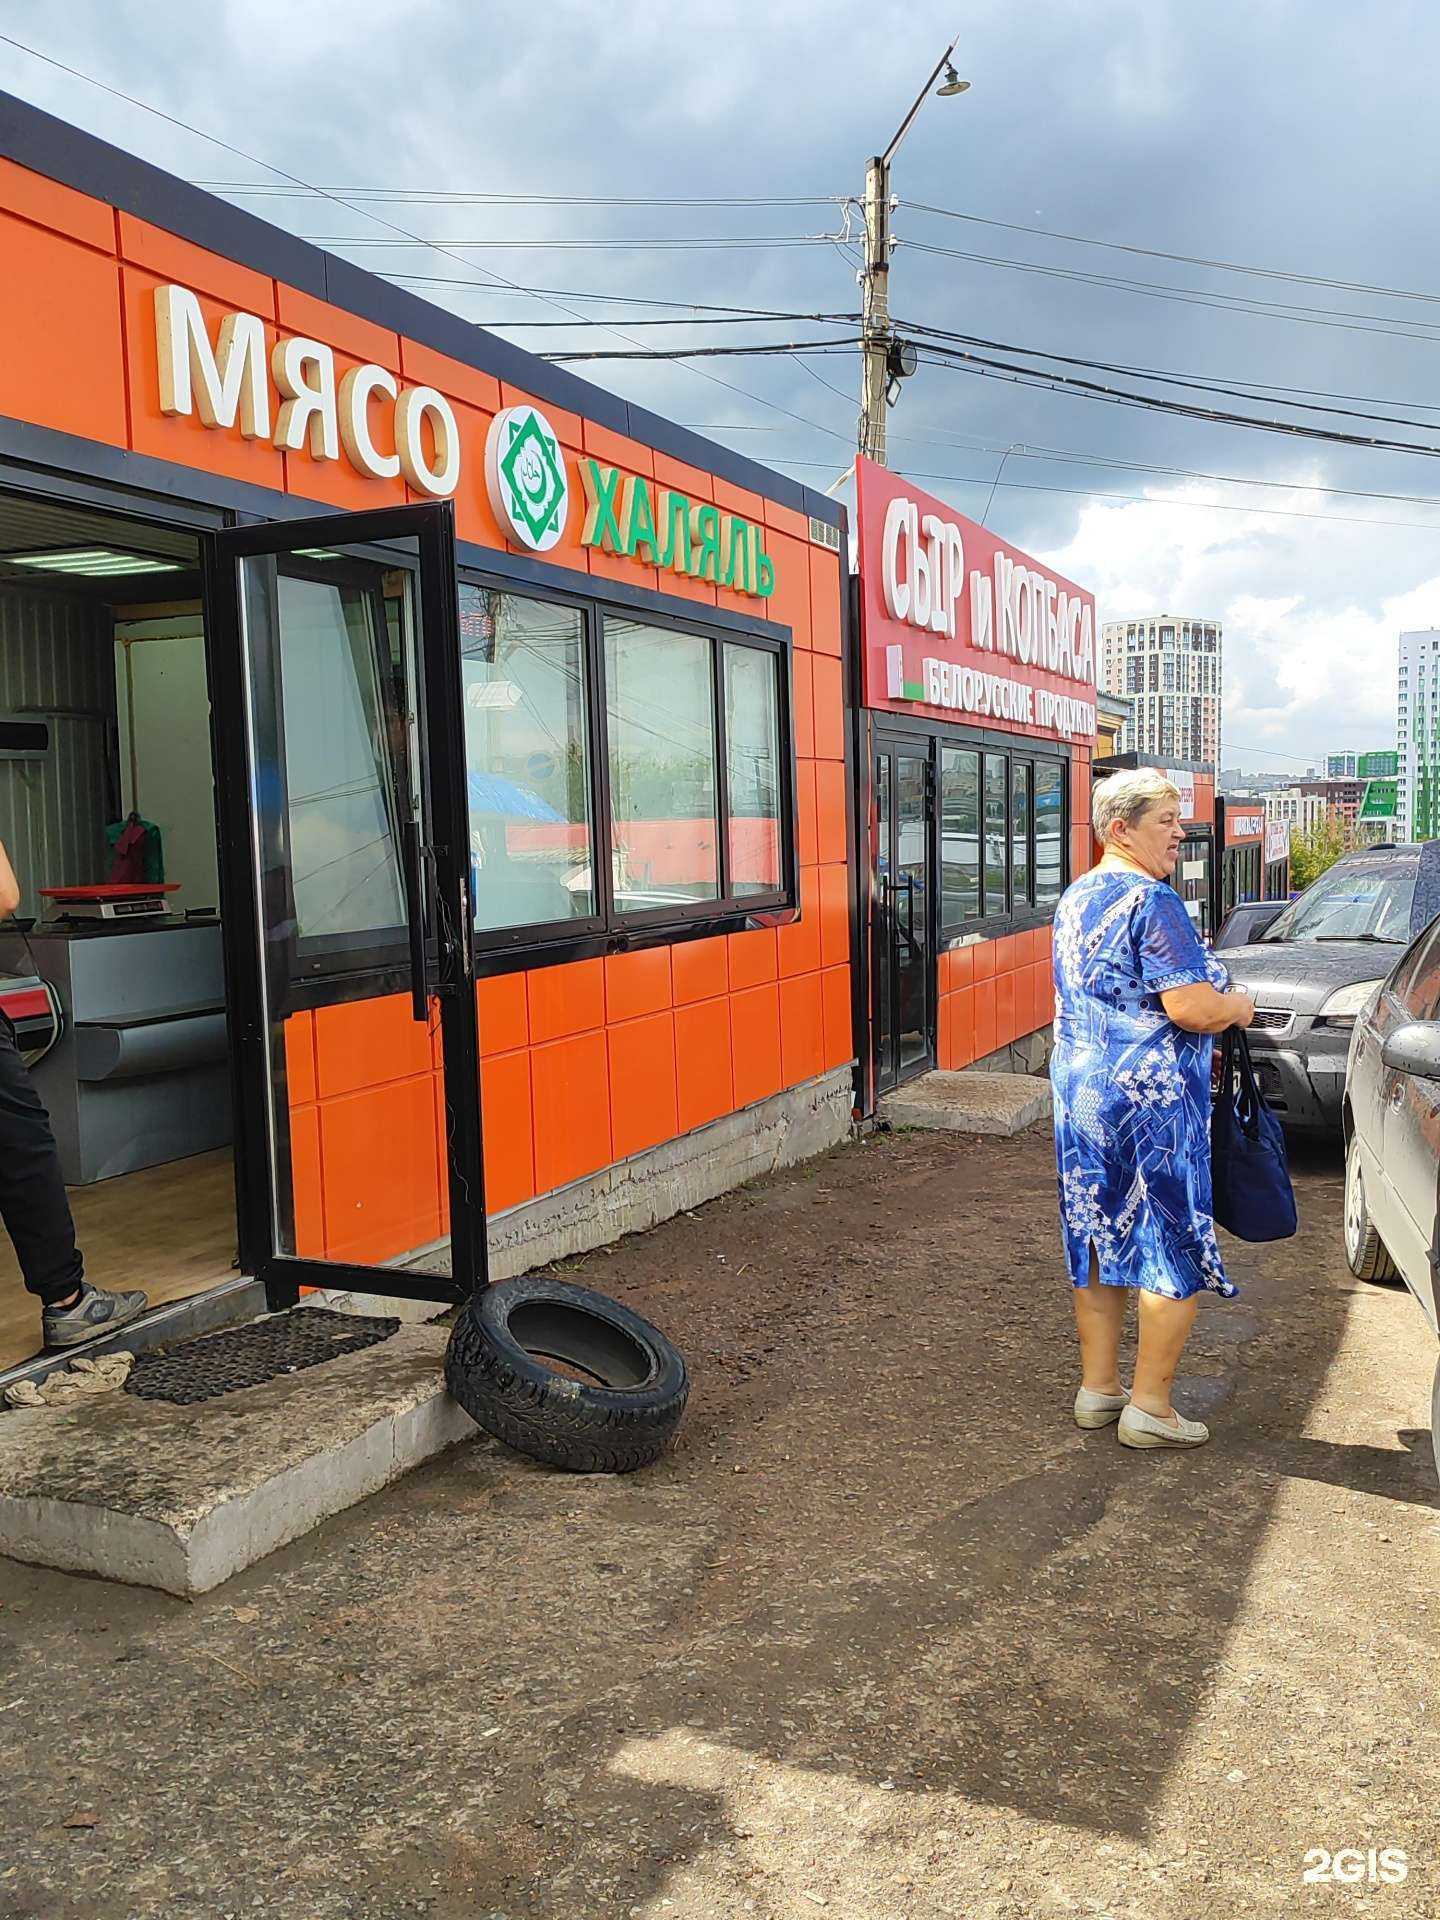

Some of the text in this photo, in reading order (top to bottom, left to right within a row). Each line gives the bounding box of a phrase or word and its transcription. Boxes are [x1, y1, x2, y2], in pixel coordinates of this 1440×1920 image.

[154, 284, 775, 598] МЯСО ХАЛЯЛЬ
[882, 498, 964, 640] СЫР
[923, 657, 1096, 739] БЕЛОРУССКИЕ ПРОДУКТЫ
